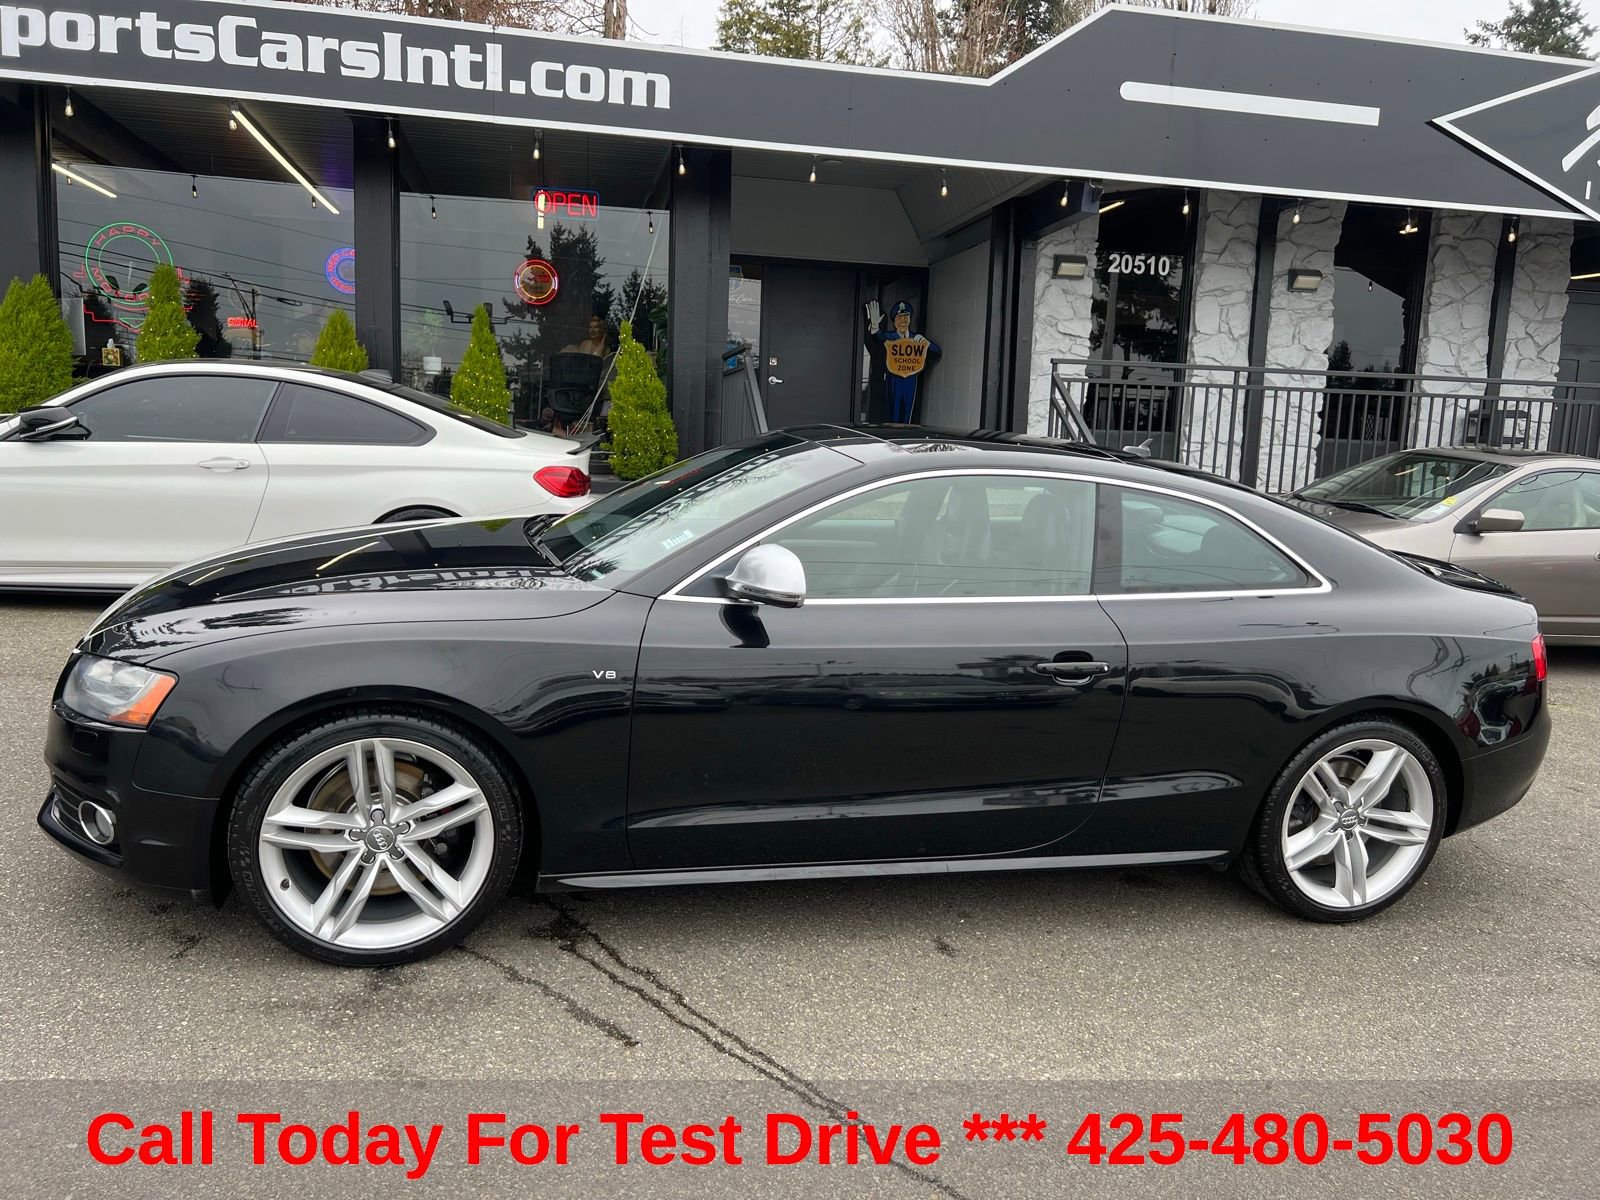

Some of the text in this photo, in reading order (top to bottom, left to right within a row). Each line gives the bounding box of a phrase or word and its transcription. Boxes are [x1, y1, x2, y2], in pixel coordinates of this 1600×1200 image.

[534, 190, 598, 218] OPEN
[95, 225, 161, 247] HAPPY
[1107, 253, 1170, 276] 20510
[891, 344, 925, 357] SLOW
[893, 357, 921, 365] SCHOOL
[592, 670, 616, 679] V8
